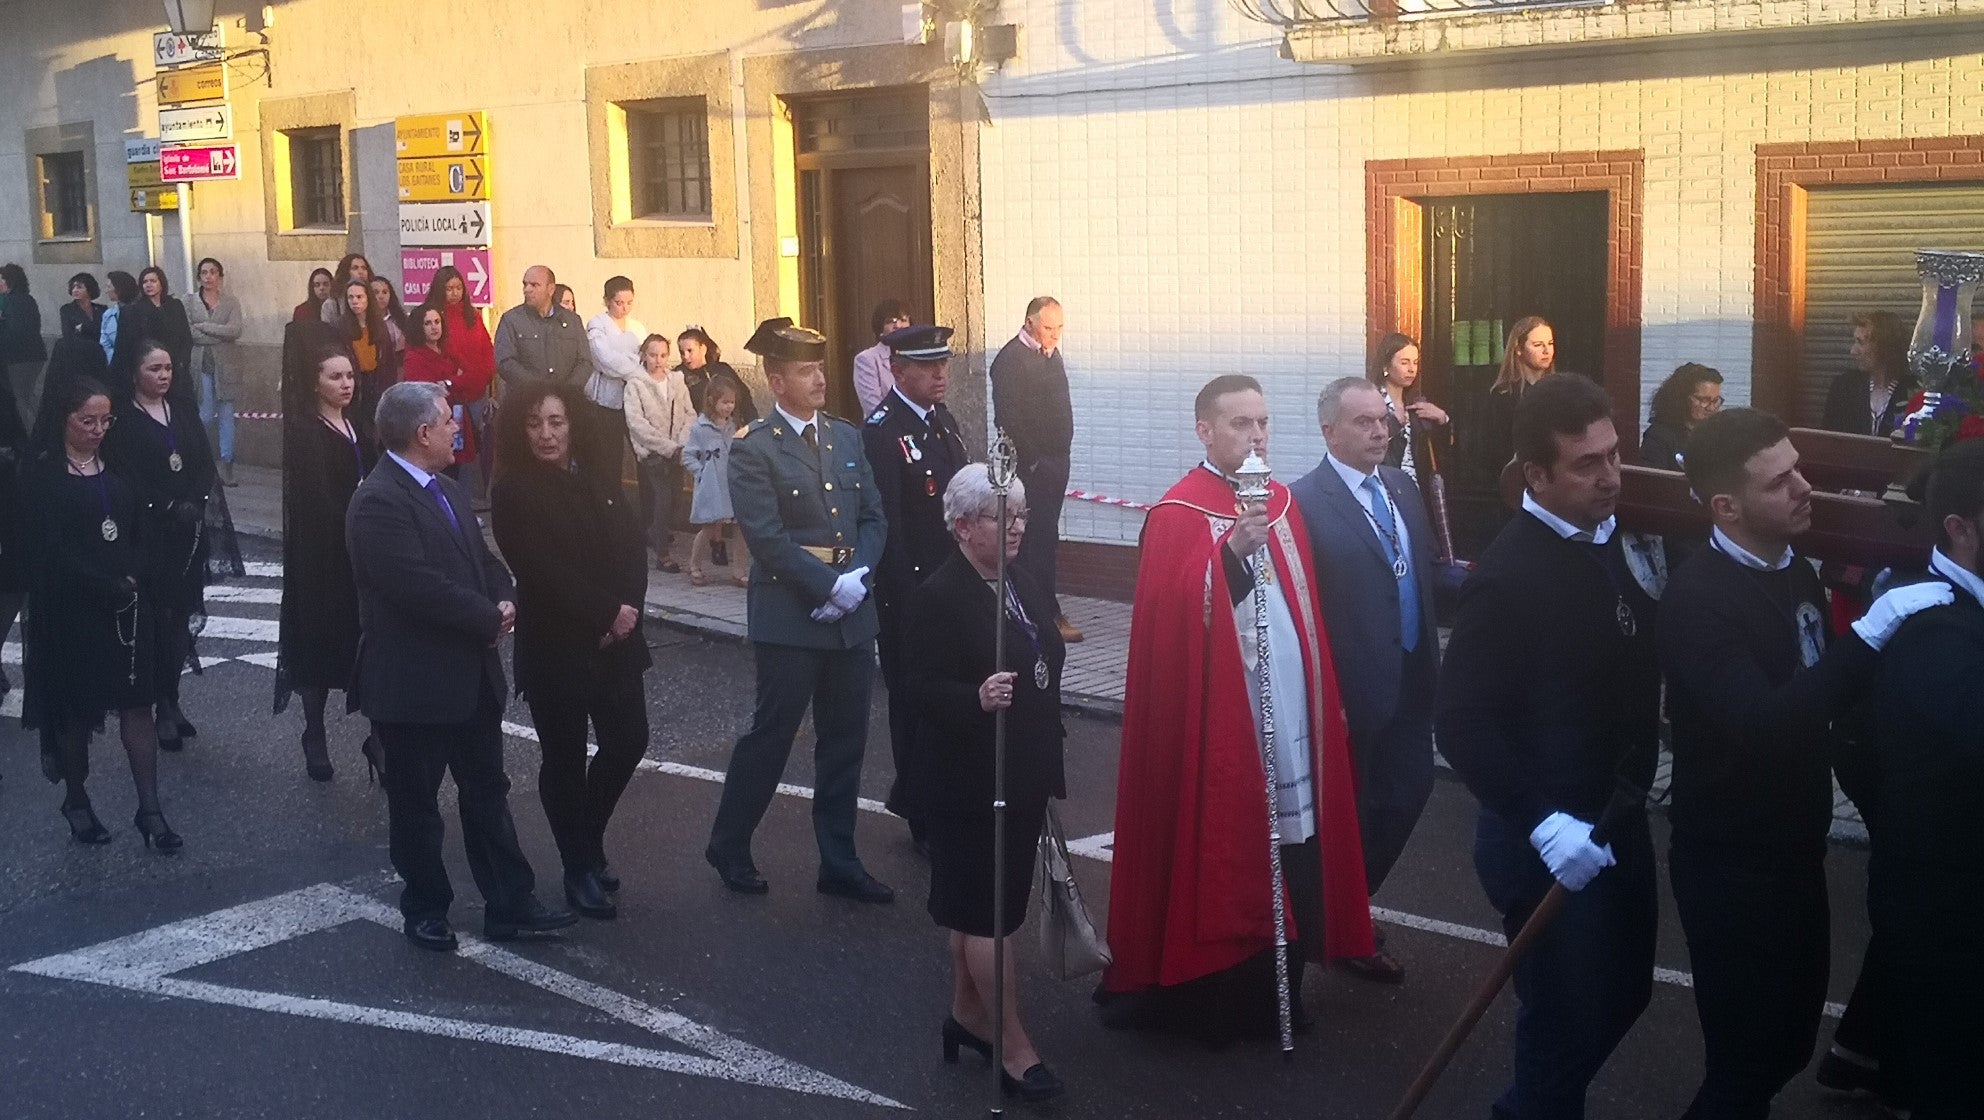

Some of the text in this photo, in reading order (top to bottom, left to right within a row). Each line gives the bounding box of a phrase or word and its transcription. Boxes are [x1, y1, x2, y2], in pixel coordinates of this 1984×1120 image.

[197, 79, 222, 89] correos
[161, 118, 203, 133] ayuntamiento
[397, 127, 440, 140] AYUNTAMIENTO
[127, 143, 150, 159] guardia
[399, 161, 435, 174] CASA RURAL
[399, 174, 440, 187] LOS GAITANES
[401, 216, 457, 232] POLICÍA LOCAL
[403, 257, 440, 270] BIBLIOTECA
[404, 283, 421, 294] CASA
